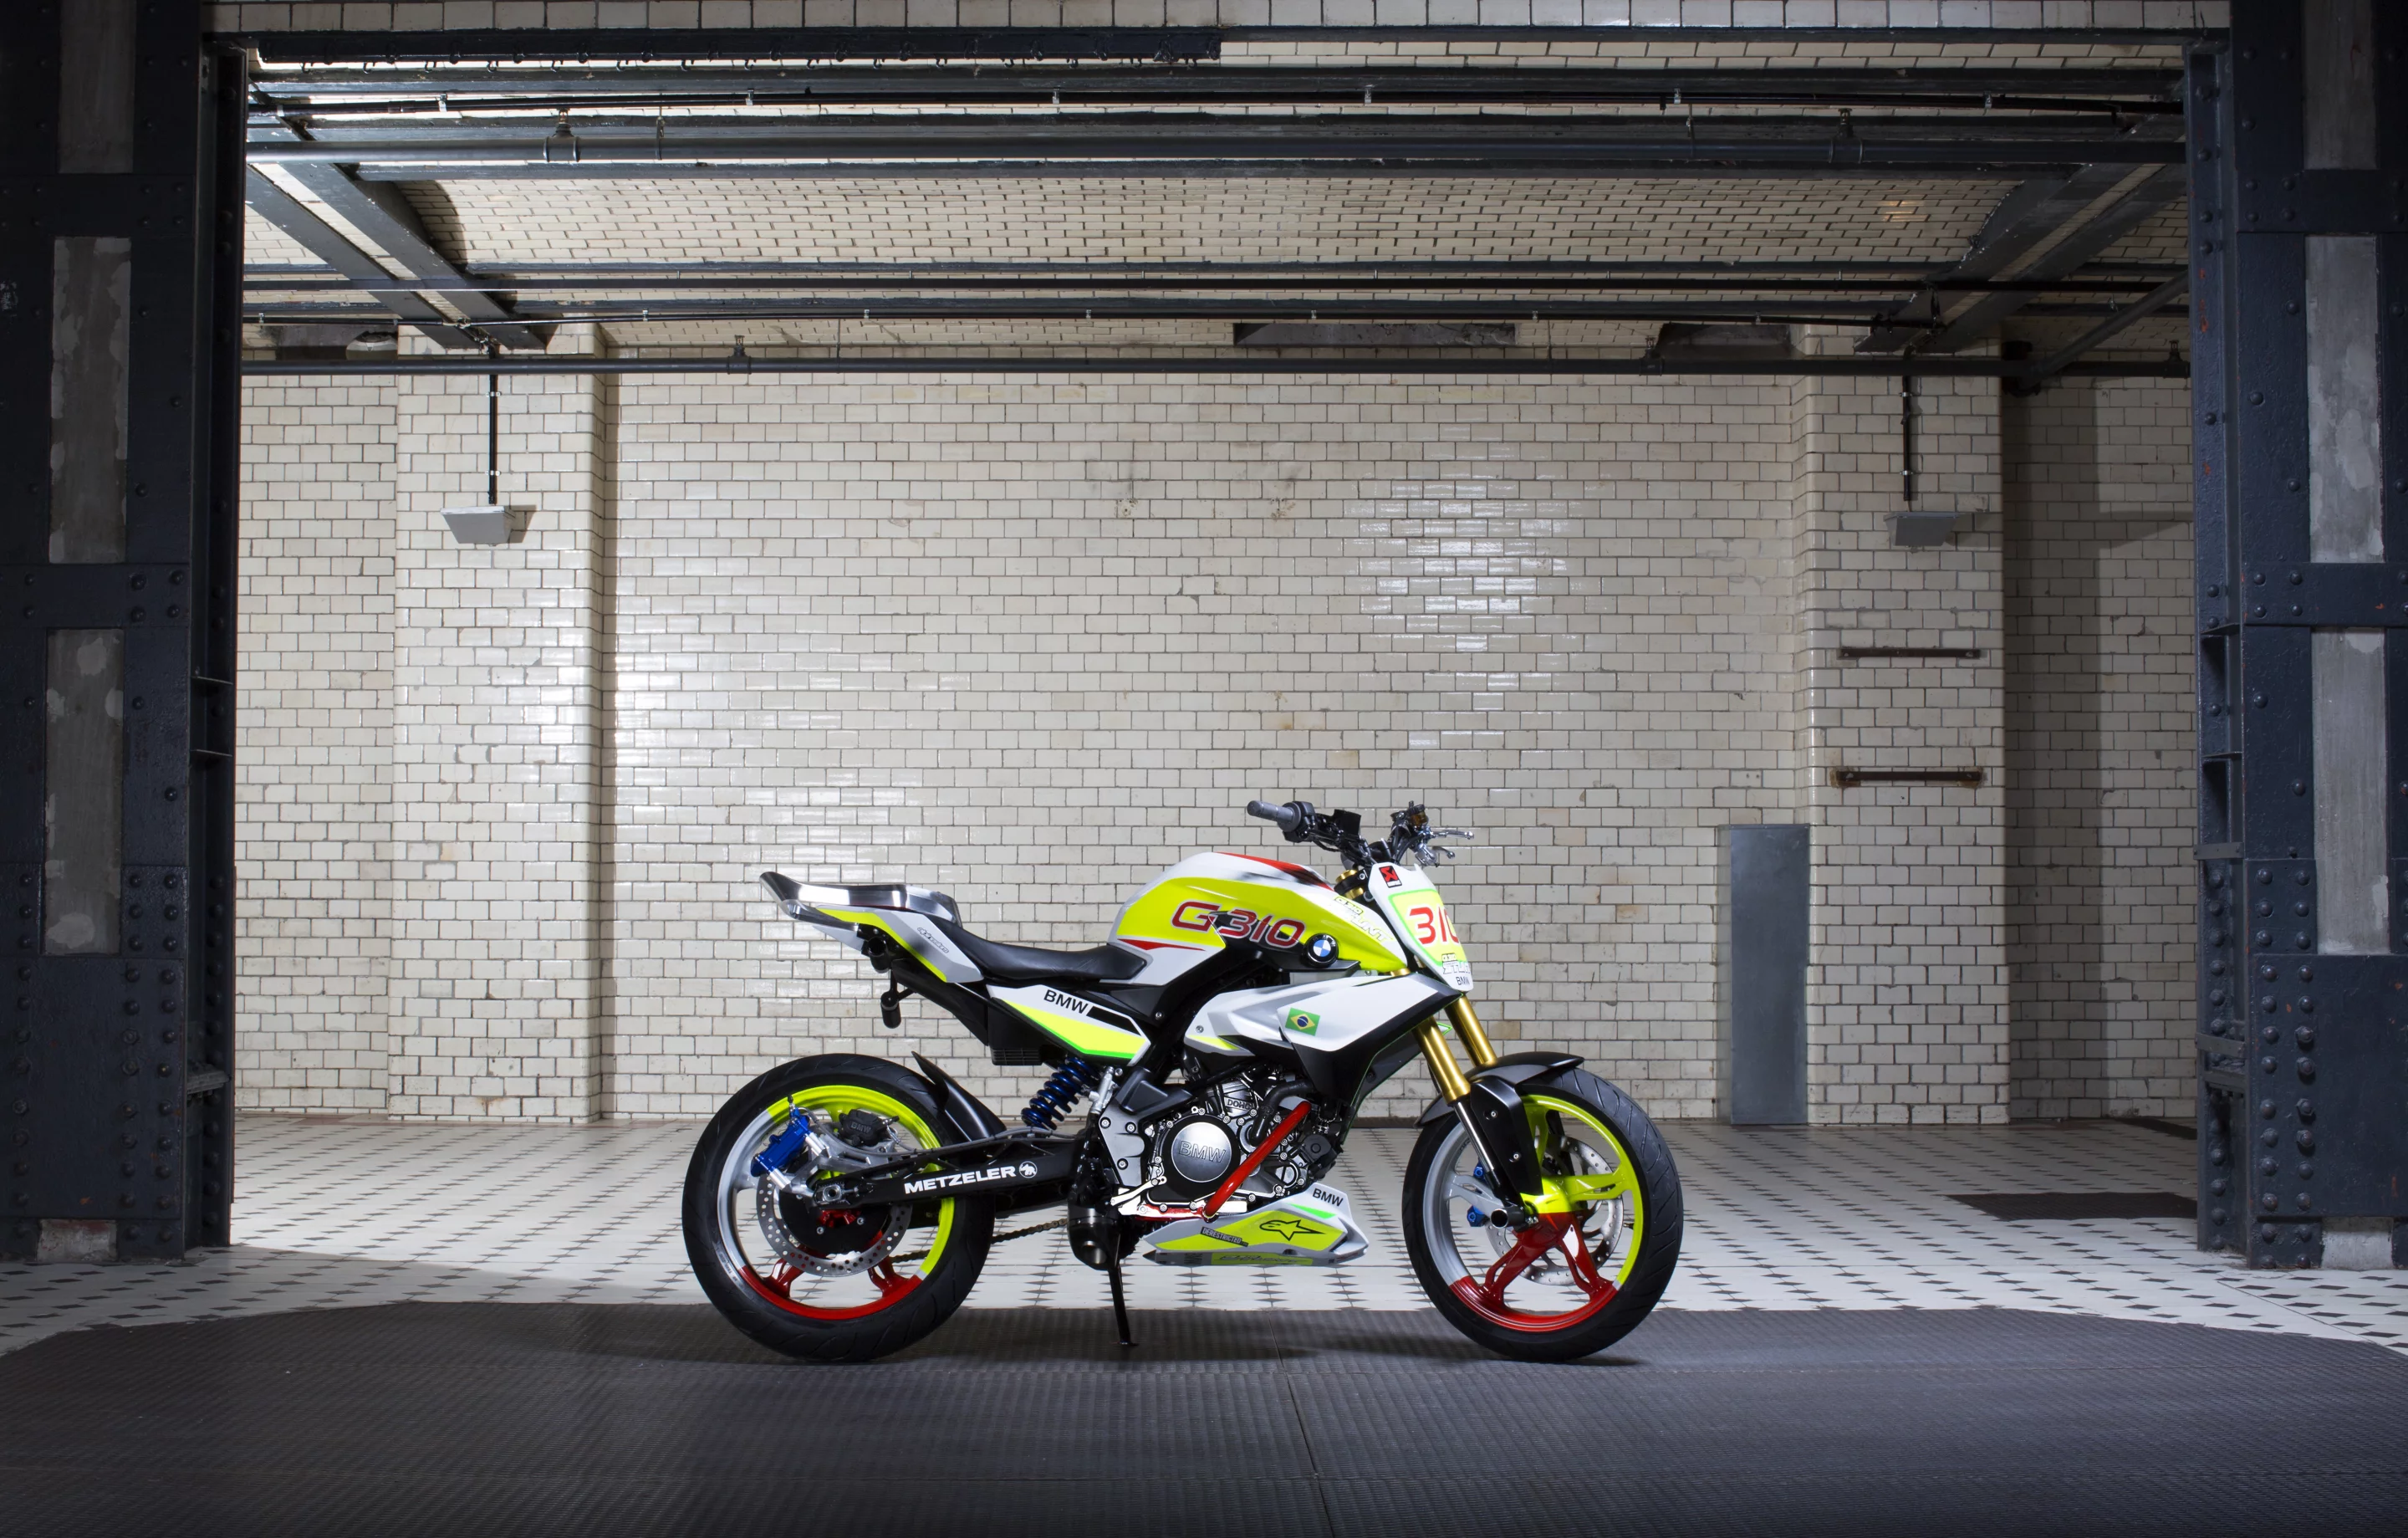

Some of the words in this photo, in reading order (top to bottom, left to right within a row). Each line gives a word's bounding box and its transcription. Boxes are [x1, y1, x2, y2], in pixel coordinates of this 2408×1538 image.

[1456, 976, 1471, 986] BMW
[1043, 989, 1089, 1014] BMW
[1227, 1099, 1252, 1111] DOHC
[850, 1122, 871, 1133] BMW
[1179, 1140, 1227, 1163] BMW
[904, 1166, 1016, 1194] METZELER
[1313, 1188, 1344, 1207] BMW
[1202, 1227, 1242, 1244] DERESTRICTED
